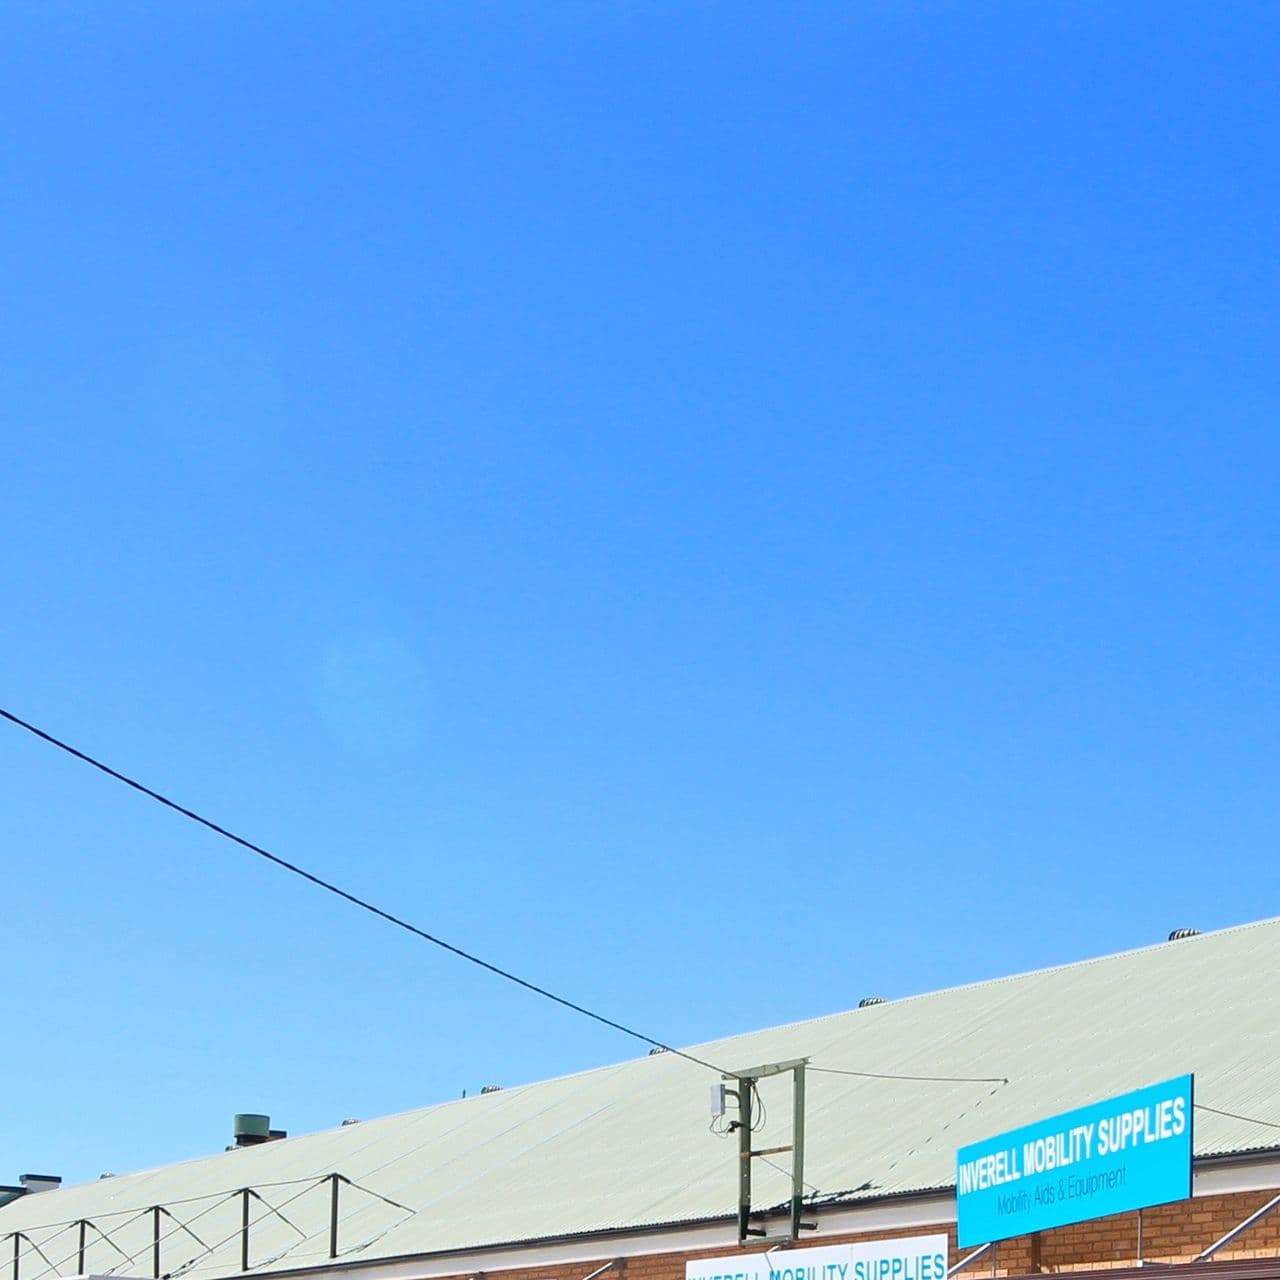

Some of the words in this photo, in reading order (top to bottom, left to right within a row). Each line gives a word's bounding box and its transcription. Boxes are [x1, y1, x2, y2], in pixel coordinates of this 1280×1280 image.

[959, 1148, 1021, 1195] INVERELL
[1023, 1123, 1094, 1177] MOBILITY
[1097, 1096, 1185, 1156] SUPPLIES
[997, 1188, 1033, 1217] Mobility
[1034, 1180, 1055, 1206] Aids
[1058, 1179, 1065, 1201] &
[1069, 1166, 1126, 1201] Equipment
